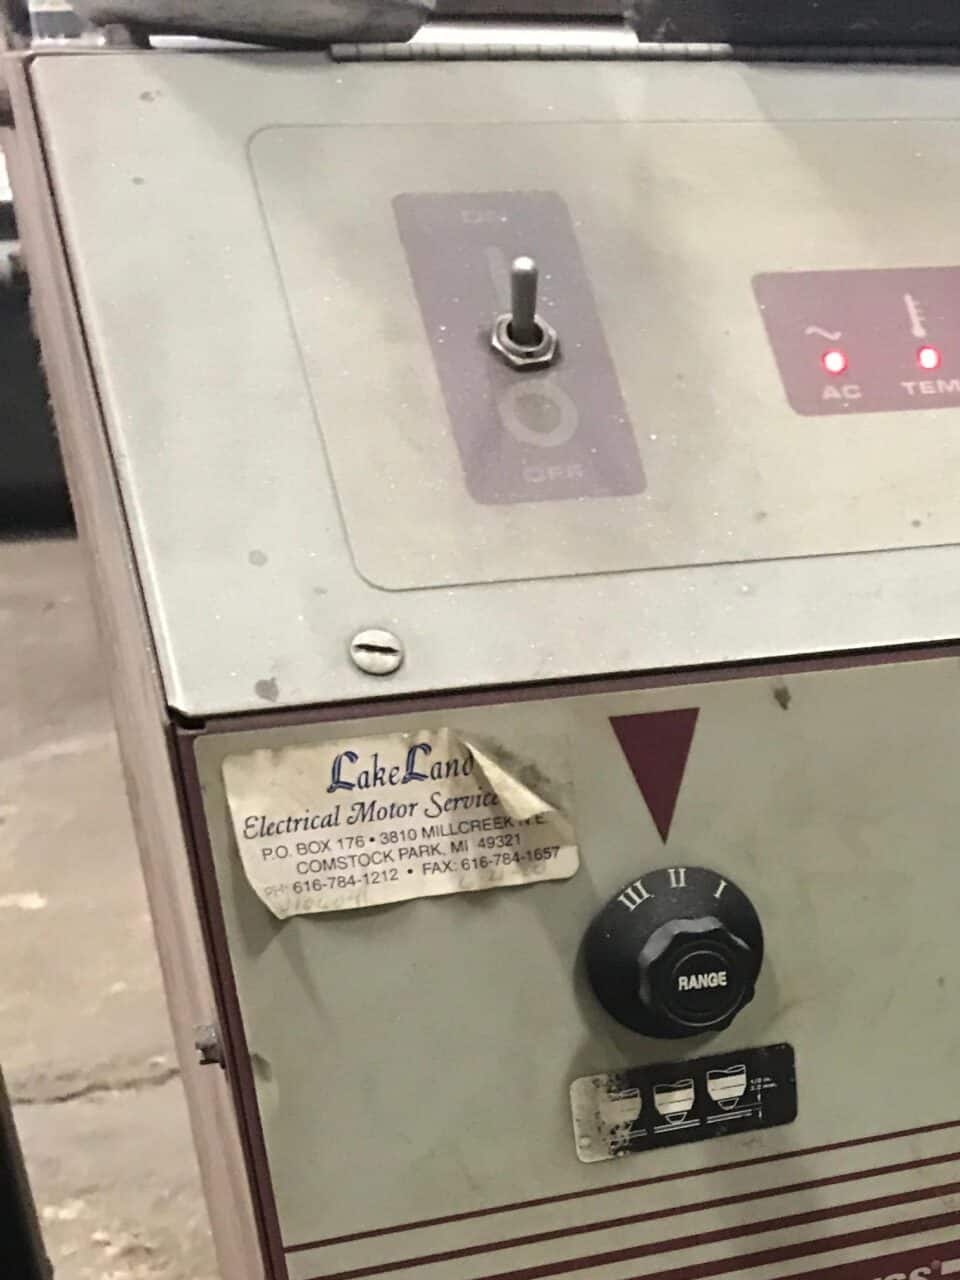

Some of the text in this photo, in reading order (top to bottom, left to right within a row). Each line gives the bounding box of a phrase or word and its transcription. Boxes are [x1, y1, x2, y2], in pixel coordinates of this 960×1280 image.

[821, 384, 863, 400] AC
[243, 804, 341, 841] Electrical
[347, 801, 419, 827] Motor
[297, 837, 332, 856] BOX
[337, 834, 366, 850] 176
[380, 829, 418, 846] 3810
[422, 815, 515, 839] MILLCREEK
[292, 867, 400, 895] 616-784-1212
[422, 860, 459, 876] FAX:
[461, 846, 562, 872] 616-784-1657
[296, 850, 395, 876] COMSTOCK
[450, 839, 470, 854] MI
[477, 833, 522, 850] 49321
[667, 867, 687, 889] II
[678, 971, 728, 991] RANGE
